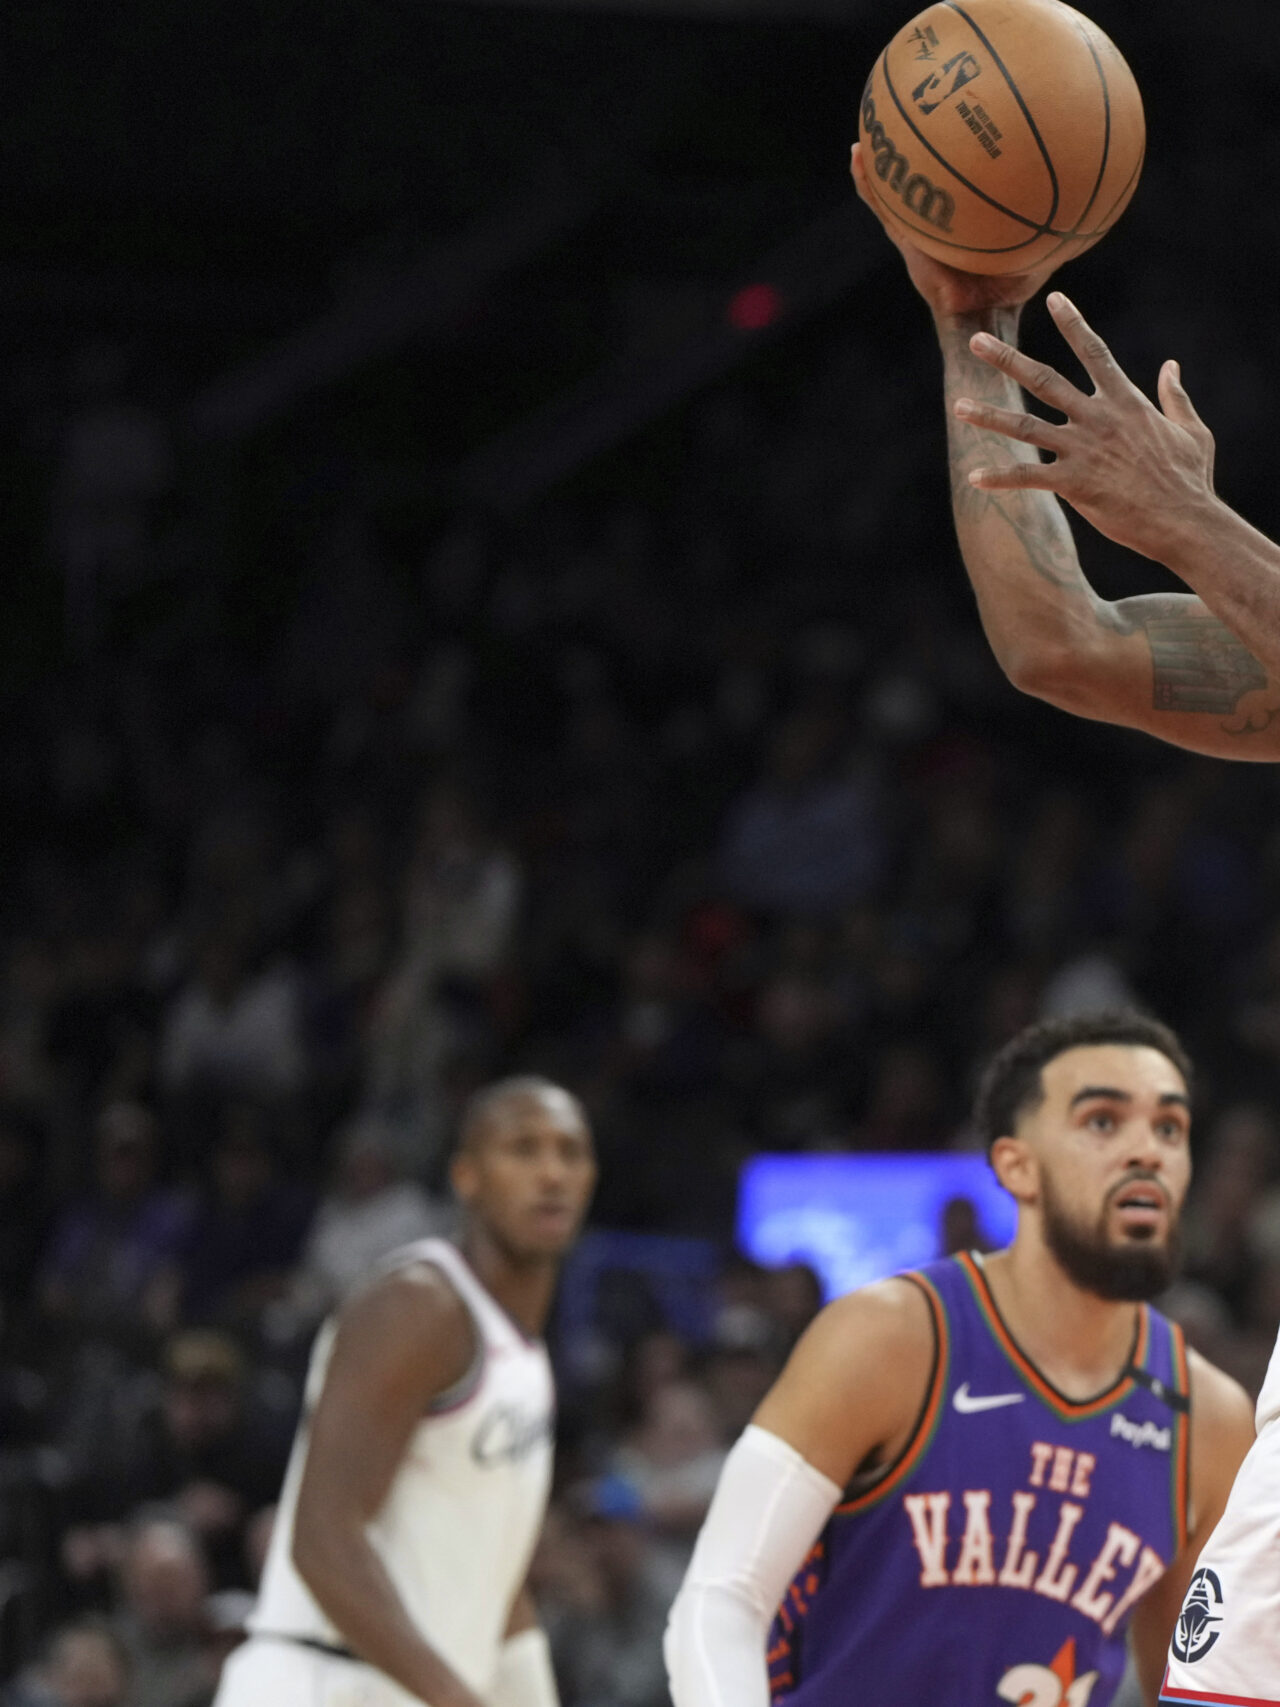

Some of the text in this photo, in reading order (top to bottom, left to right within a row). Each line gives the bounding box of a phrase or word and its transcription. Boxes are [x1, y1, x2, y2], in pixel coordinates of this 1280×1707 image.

[1111, 1413, 1171, 1454] PayPal
[1030, 1441, 1096, 1497] THE
[904, 1491, 1167, 1636] VALLEY
